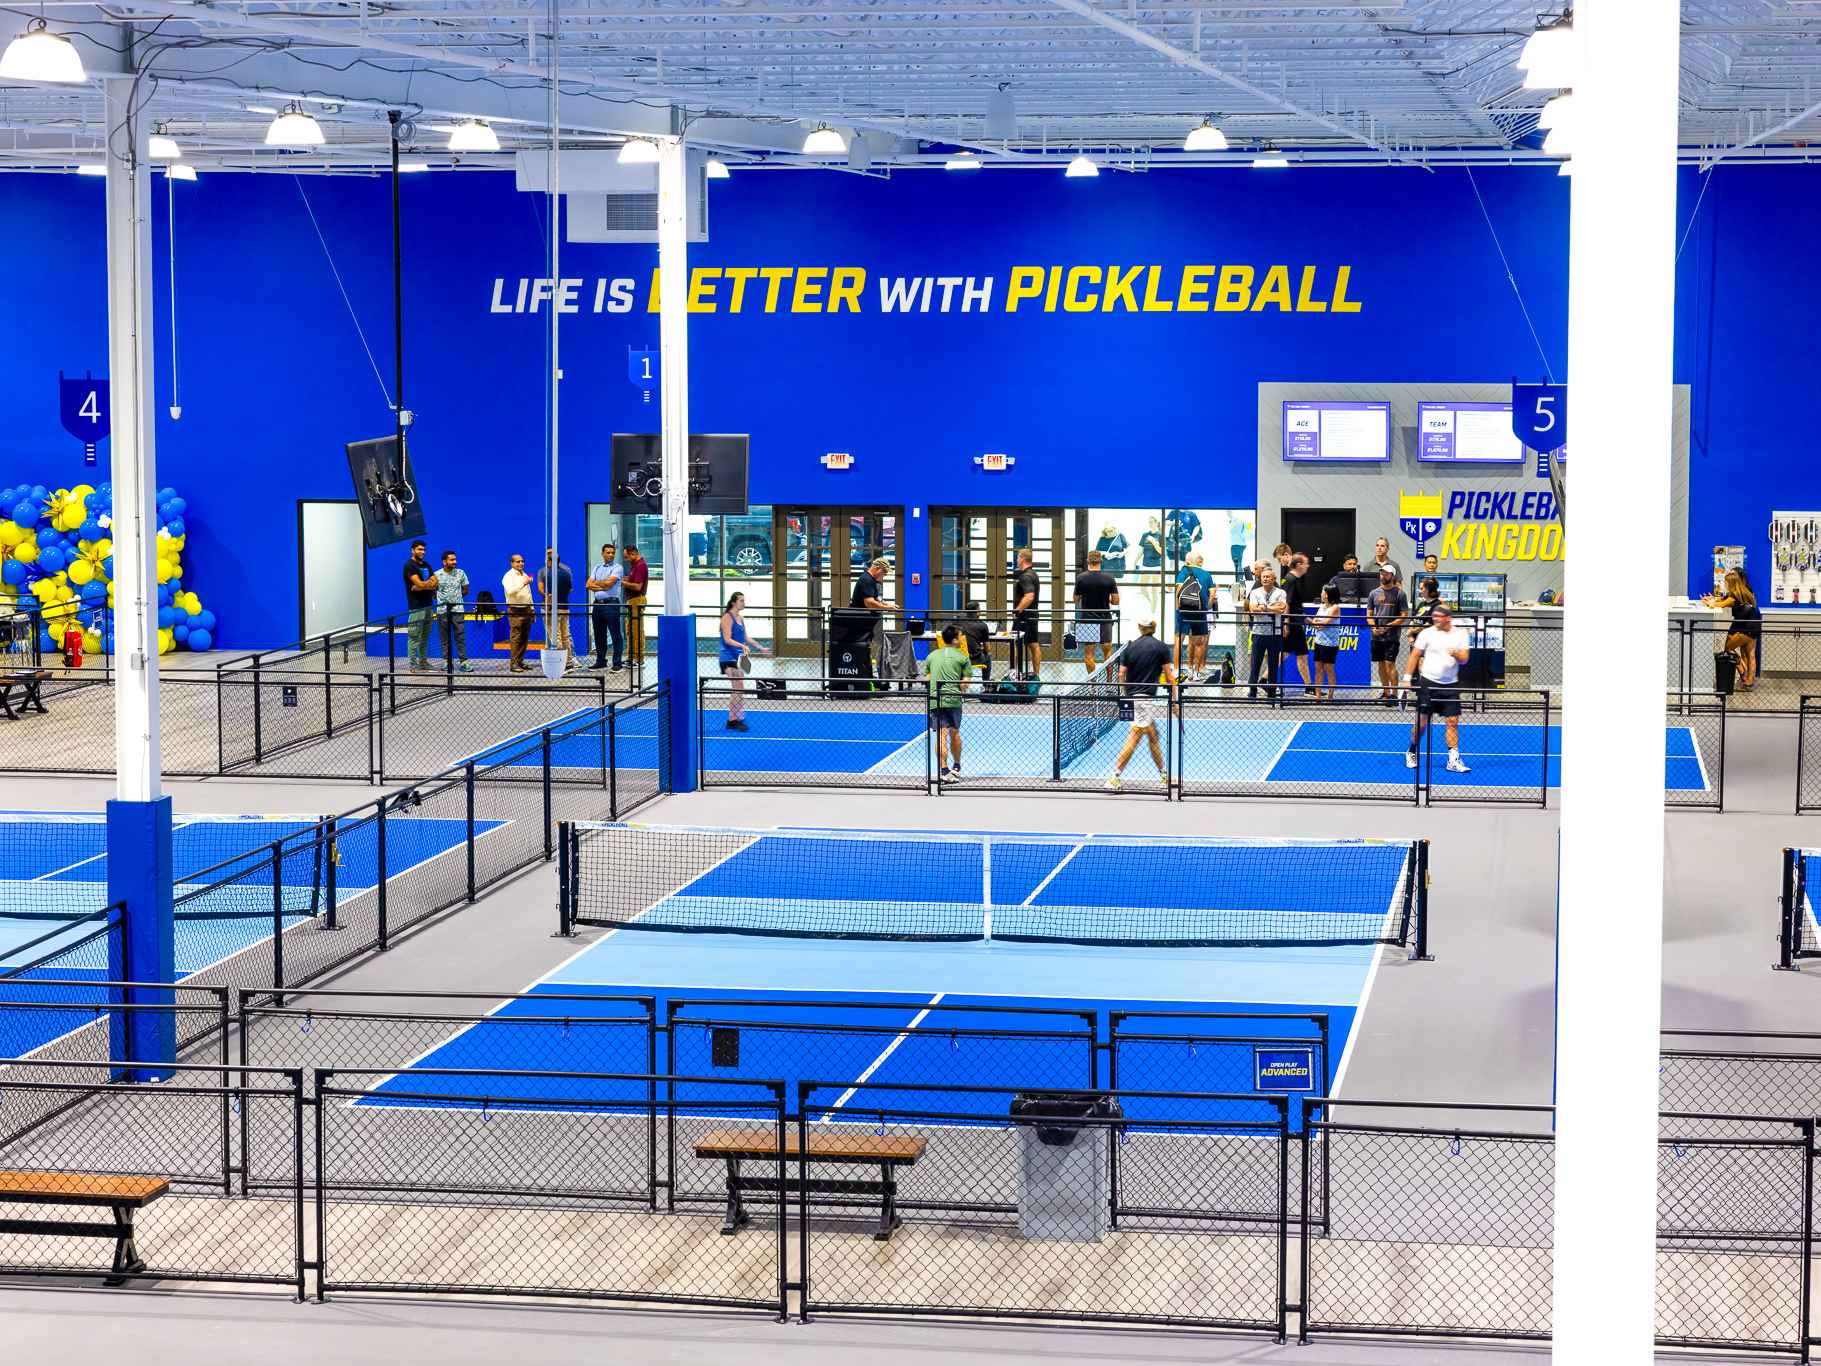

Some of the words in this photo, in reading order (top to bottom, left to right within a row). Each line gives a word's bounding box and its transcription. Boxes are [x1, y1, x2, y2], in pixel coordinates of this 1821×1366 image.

[490, 278, 583, 313] LIFE
[593, 278, 635, 313] IS
[880, 277, 994, 313] WITH
[1005, 265, 1363, 313] PICKLEBALL
[641, 357, 652, 379] 1
[78, 390, 102, 424] 4
[1533, 396, 1555, 432] 5
[830, 454, 847, 465] EXIT
[987, 455, 1003, 465] EXIT
[1440, 522, 1567, 562] KINGDO
[837, 667, 858, 675] TITAN
[1261, 1068, 1308, 1076] ADVANCED
